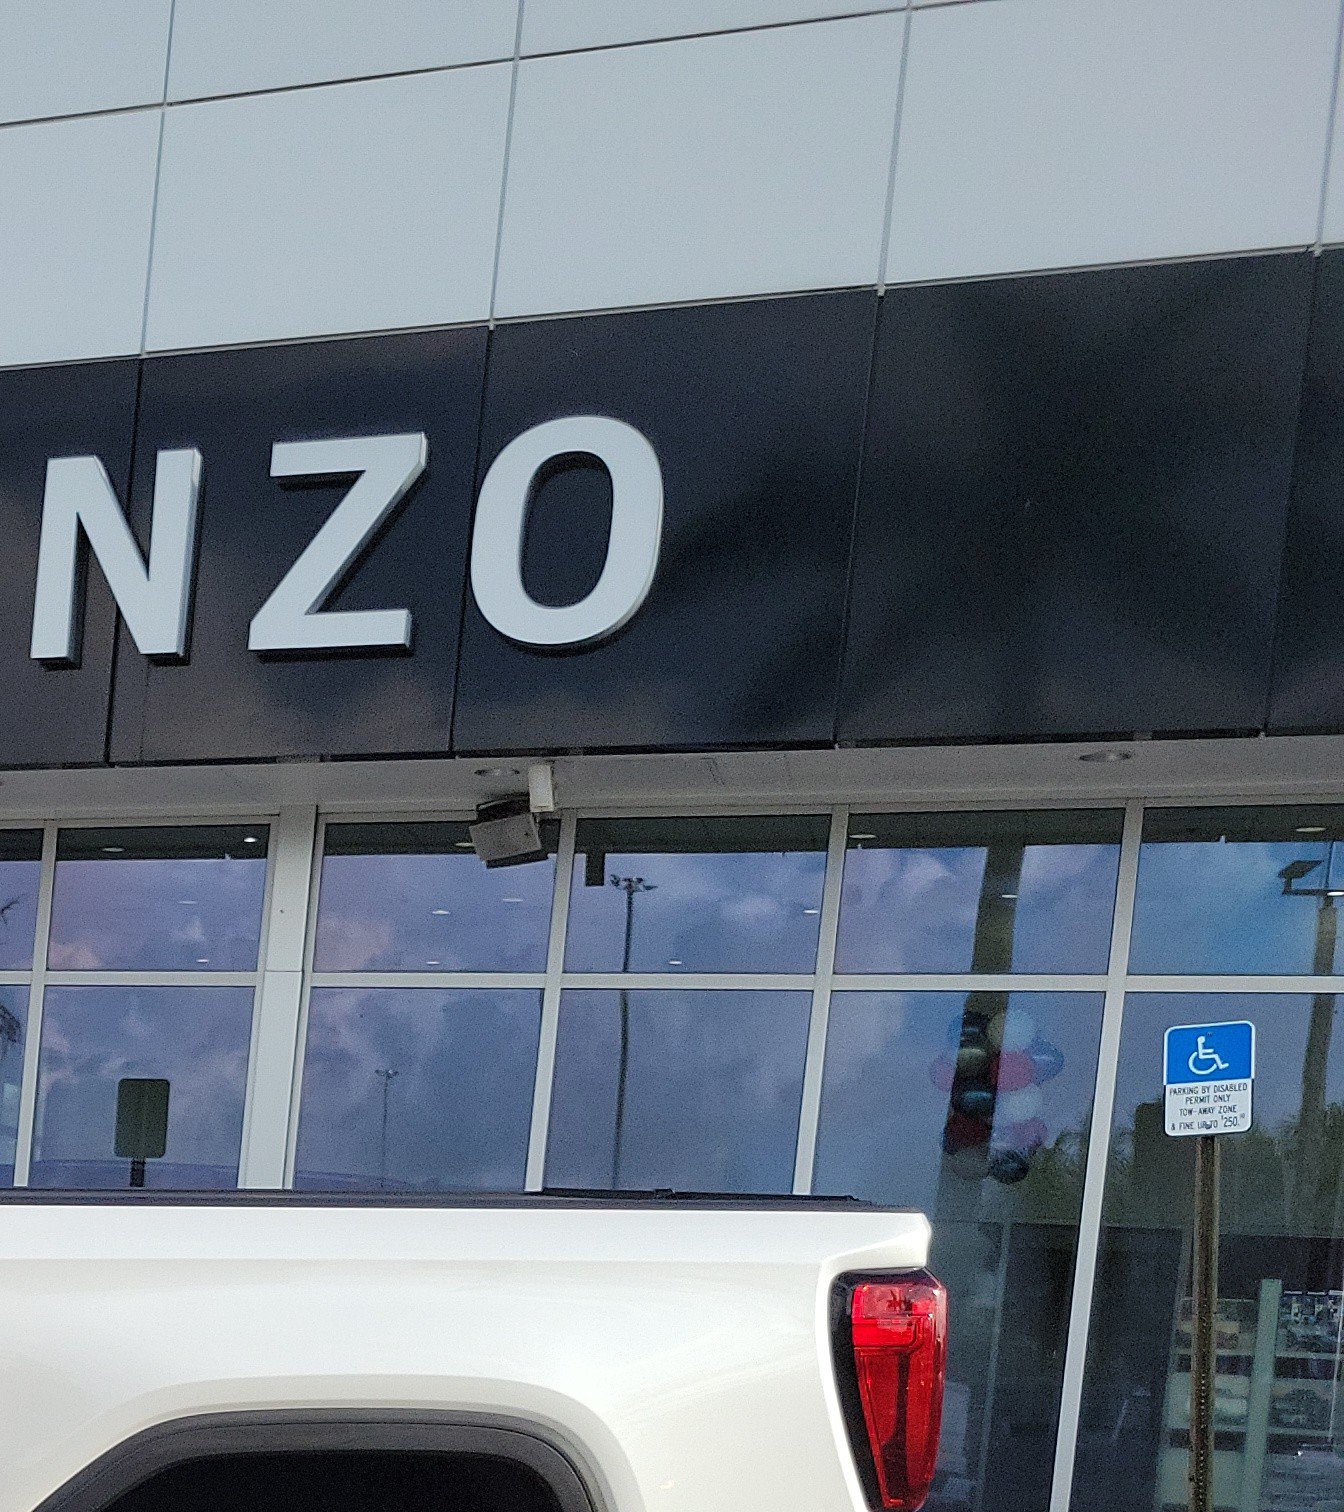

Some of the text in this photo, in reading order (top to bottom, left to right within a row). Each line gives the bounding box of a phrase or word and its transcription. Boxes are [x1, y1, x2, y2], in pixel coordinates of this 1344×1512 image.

[1169, 1082, 1248, 1096] PARKING BY DISABLED
[1185, 1094, 1231, 1105] PERMIT ONLY
[1218, 1104, 1237, 1114] ZONE
[1179, 1121, 1194, 1131] FINE
